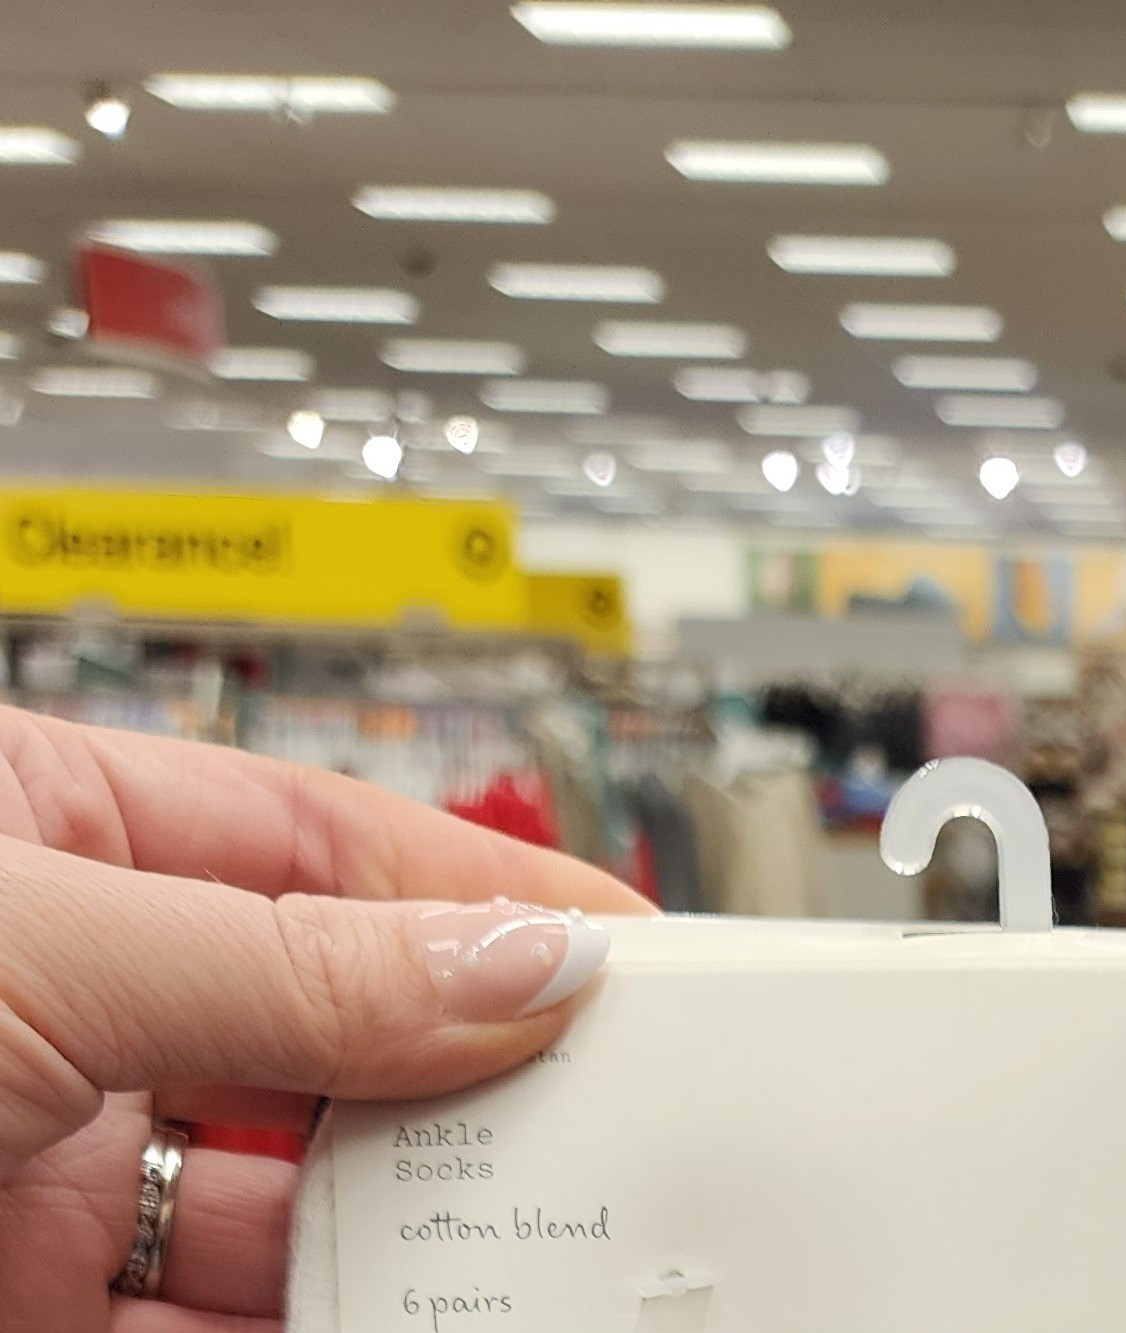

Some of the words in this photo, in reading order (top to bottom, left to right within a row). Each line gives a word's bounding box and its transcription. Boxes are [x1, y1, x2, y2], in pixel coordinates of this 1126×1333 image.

[394, 1123, 493, 1148] Ankle
[395, 1157, 494, 1182] Socks
[399, 1211, 501, 1242] cotton
[513, 1205, 611, 1241] blend
[403, 1288, 420, 1315] 6
